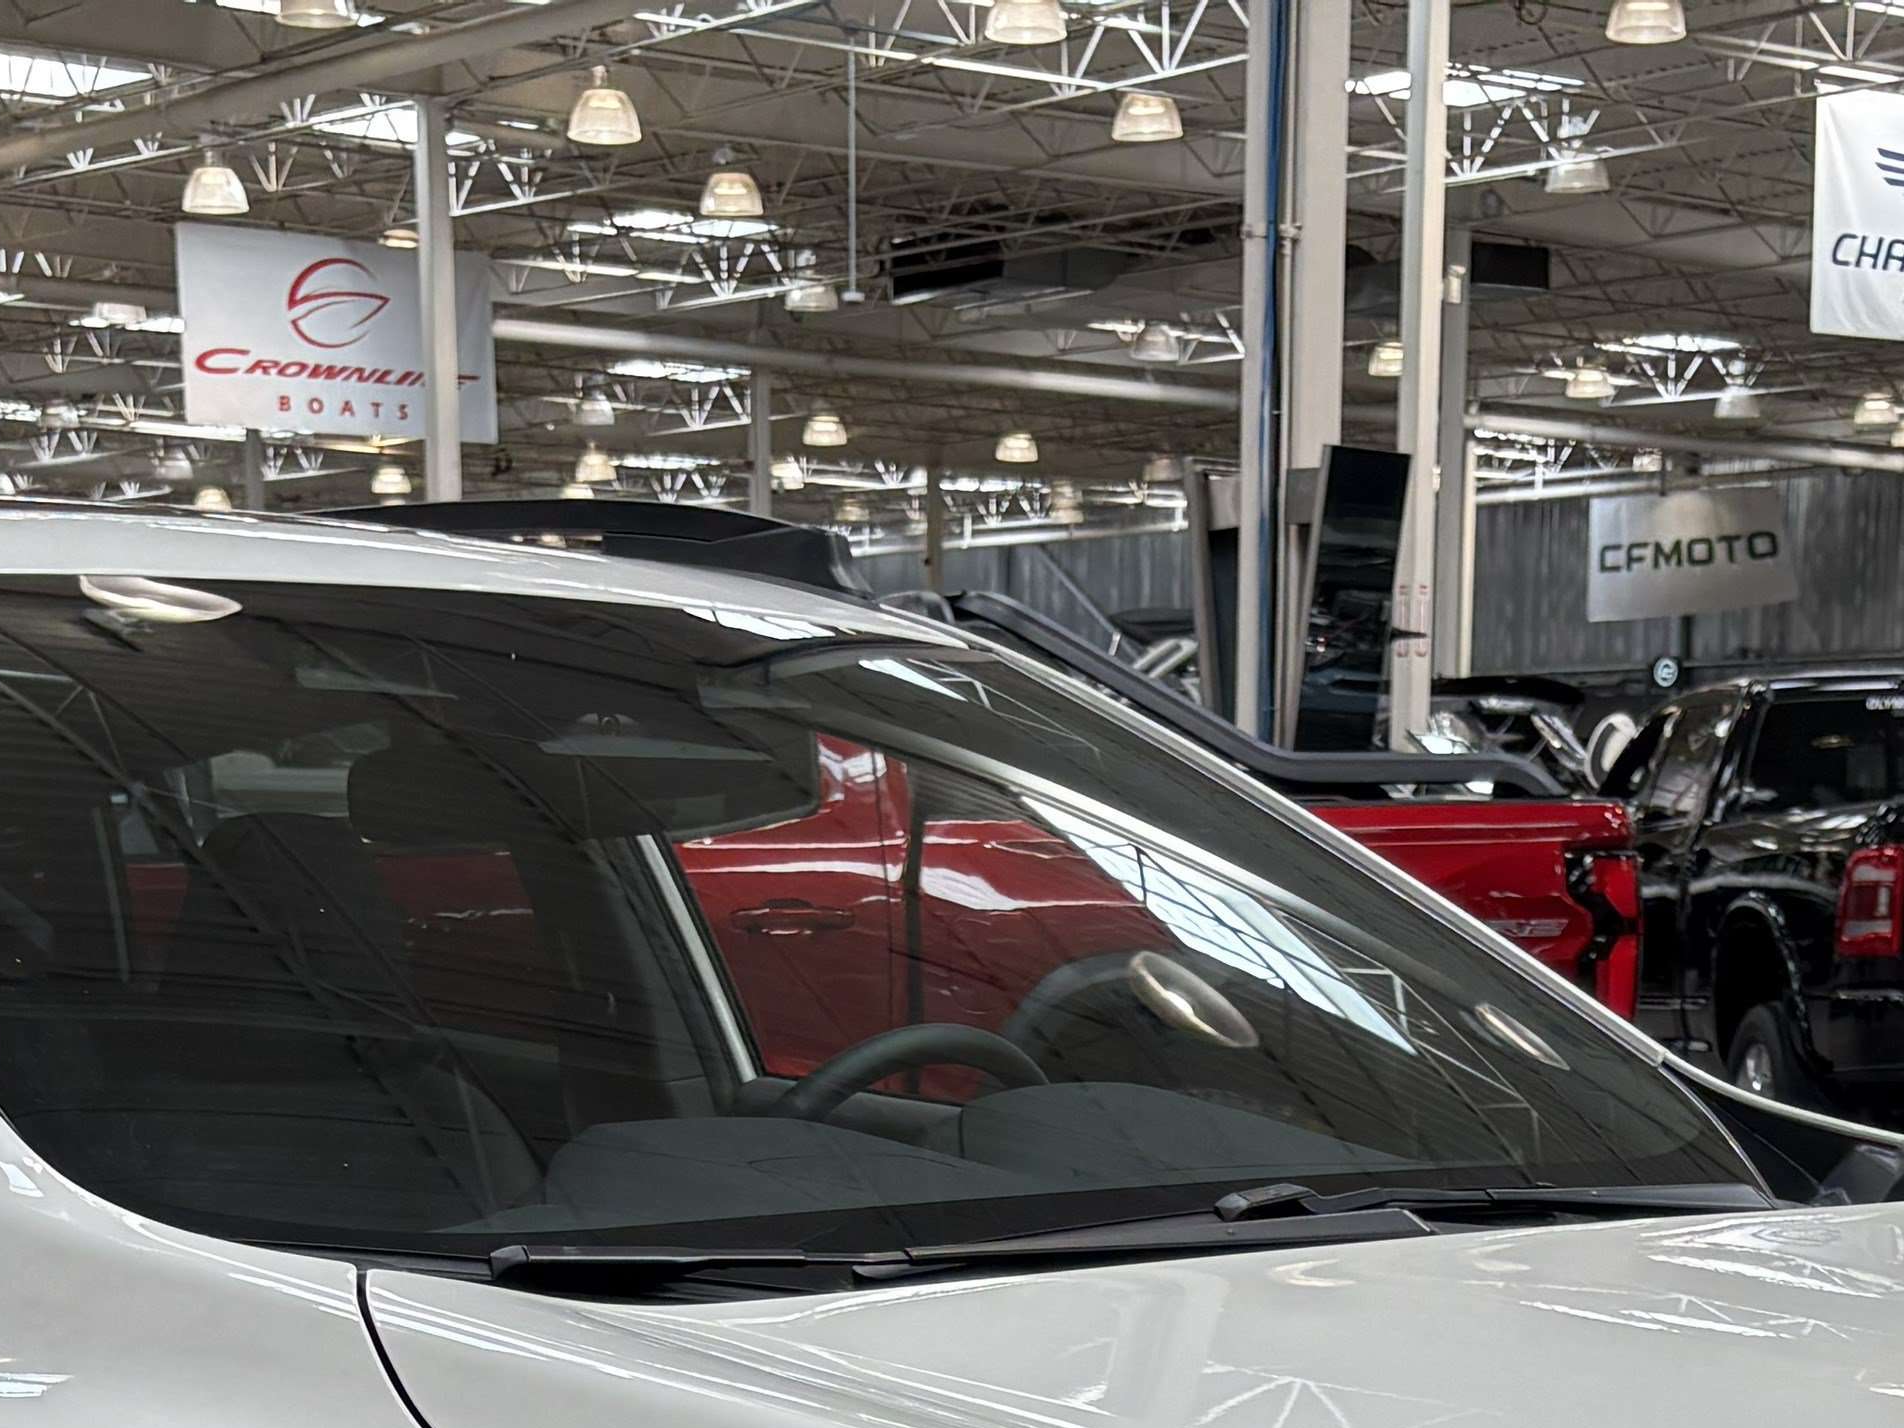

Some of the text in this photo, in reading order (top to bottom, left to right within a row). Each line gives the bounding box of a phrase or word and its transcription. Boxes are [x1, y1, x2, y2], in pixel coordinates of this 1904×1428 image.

[195, 347, 481, 391] CROWNLI
[279, 395, 409, 421] BOATS
[1599, 530, 1779, 573] CFMOTO
